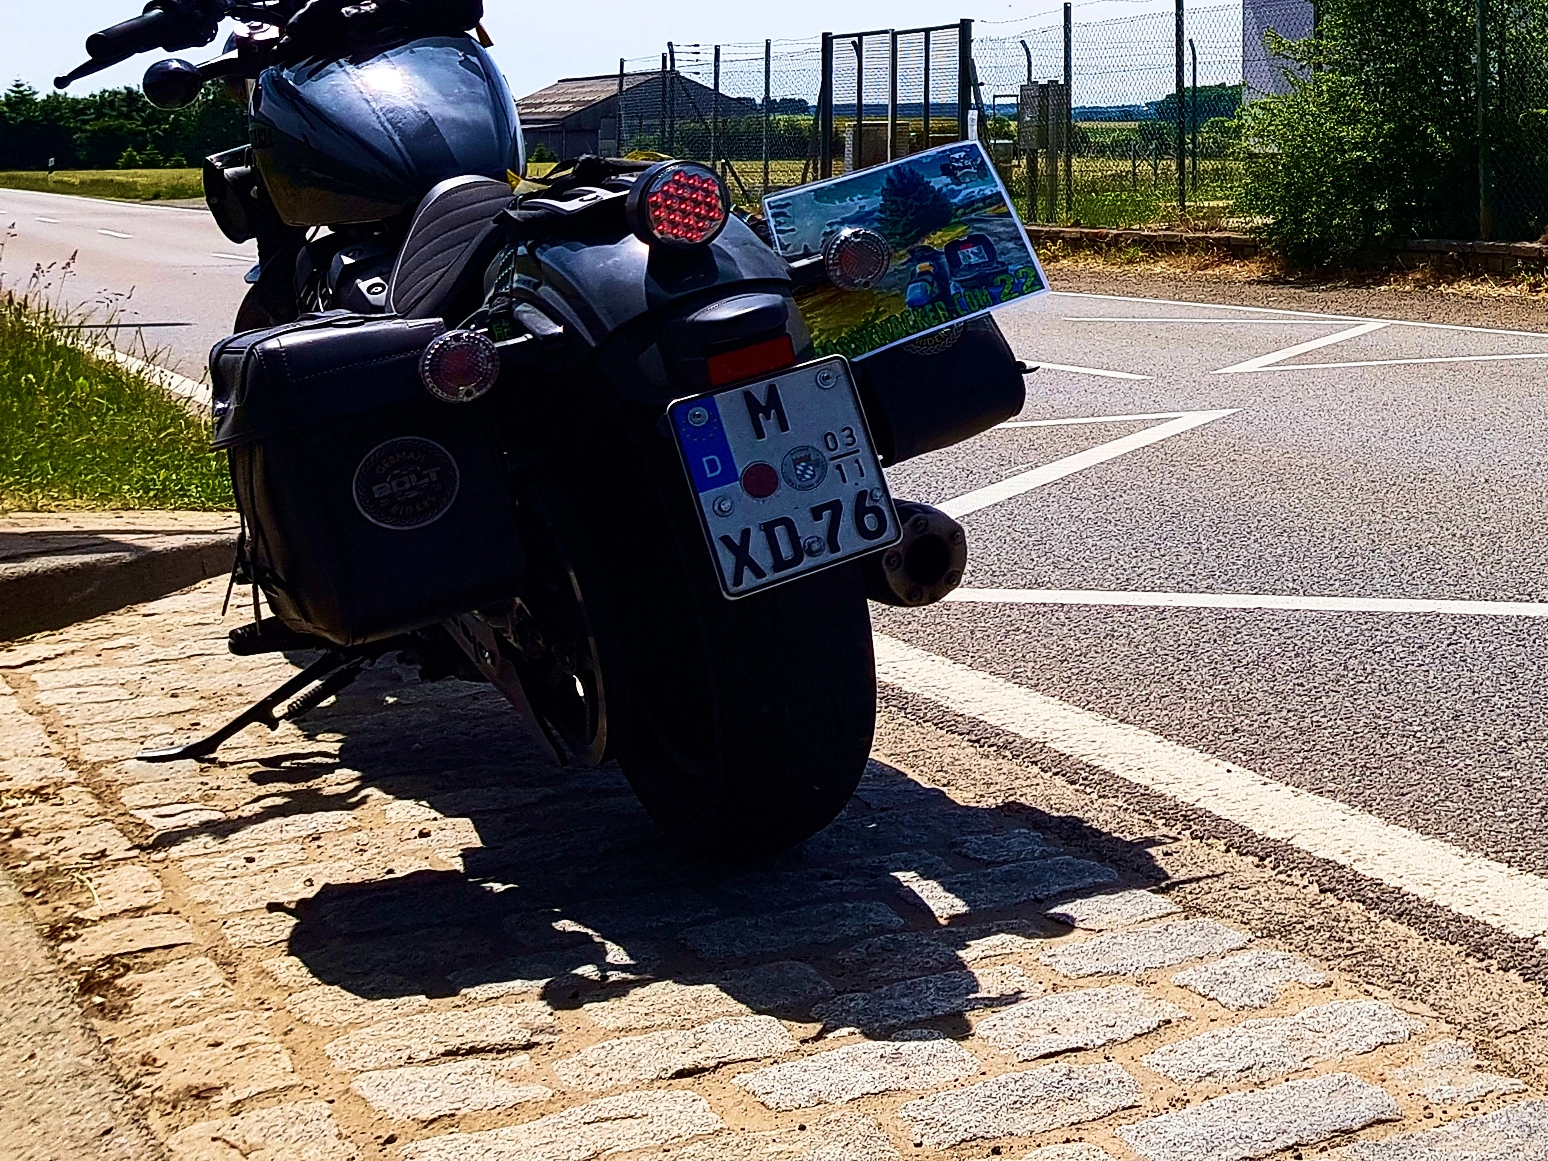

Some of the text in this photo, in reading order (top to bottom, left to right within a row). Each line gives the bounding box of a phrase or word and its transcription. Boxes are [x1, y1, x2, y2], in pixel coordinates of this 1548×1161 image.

[993, 266, 1042, 302] 22
[743, 384, 790, 441] M
[824, 426, 857, 452] 03
[702, 455, 722, 478] D
[836, 458, 866, 484] 11
[372, 467, 441, 498] BOLT
[719, 489, 888, 588] XD 76
